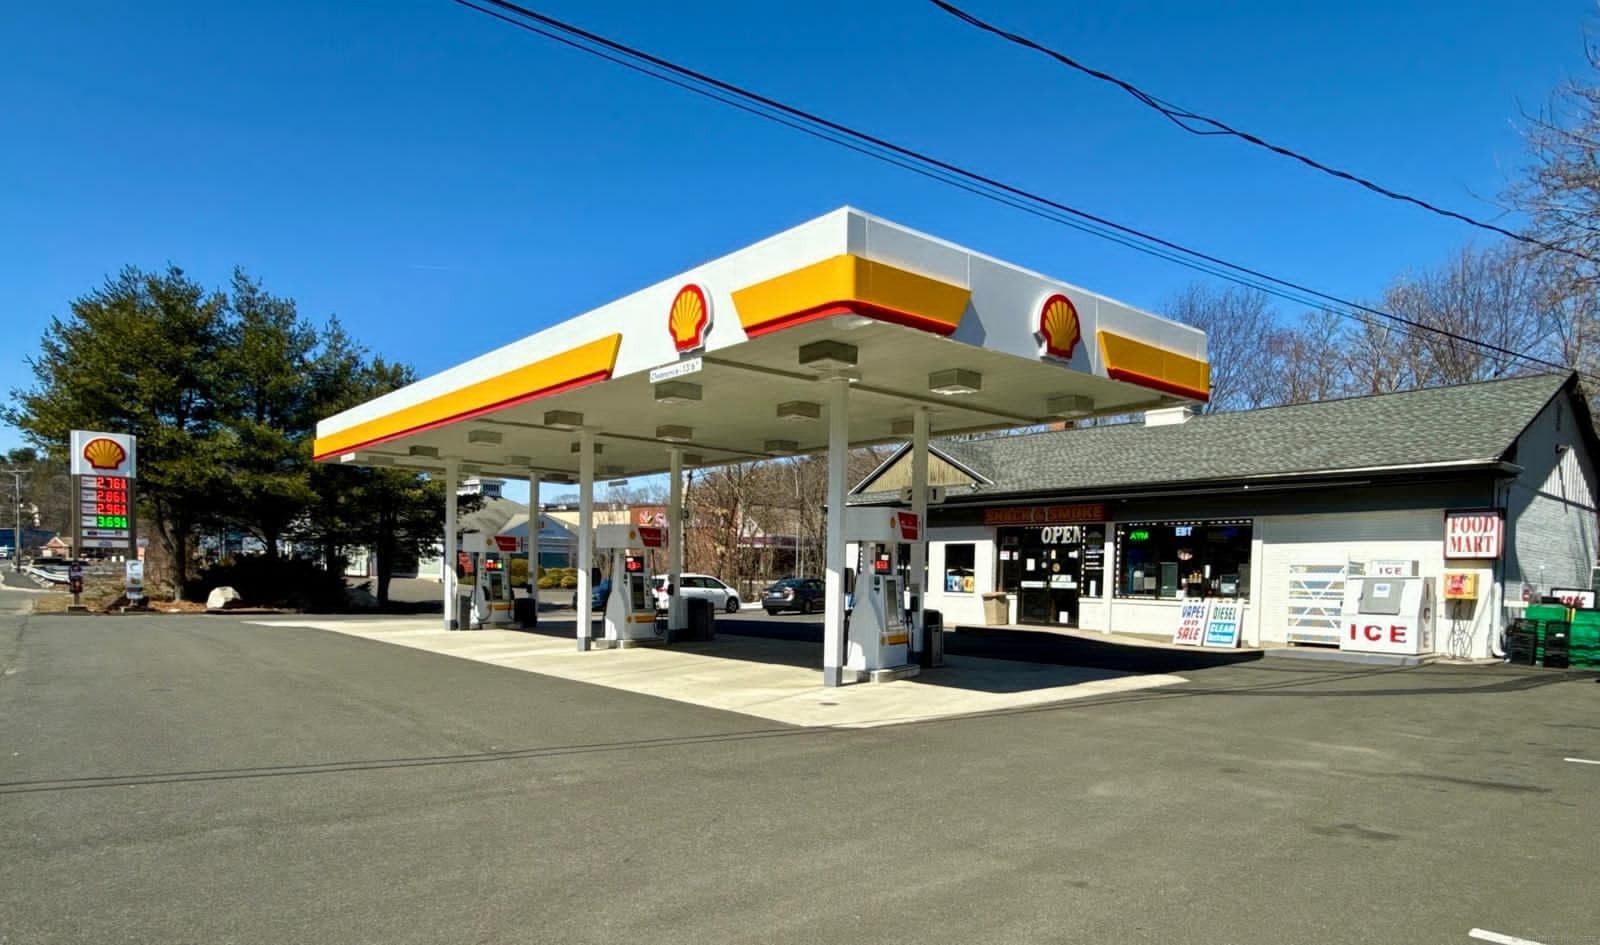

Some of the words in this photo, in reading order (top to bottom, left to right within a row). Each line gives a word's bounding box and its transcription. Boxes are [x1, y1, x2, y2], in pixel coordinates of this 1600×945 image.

[1175, 527, 1193, 537] EBT
[1450, 516, 1495, 534] FOOD
[1041, 526, 1082, 545] OPEN
[1129, 531, 1149, 541] ATM
[1449, 535, 1494, 553] MART
[1379, 567, 1402, 576] ICE
[1182, 605, 1206, 619] VAPES
[1213, 607, 1237, 620] DIESEL
[1176, 627, 1201, 641] SALE
[1350, 624, 1408, 644] ICE
